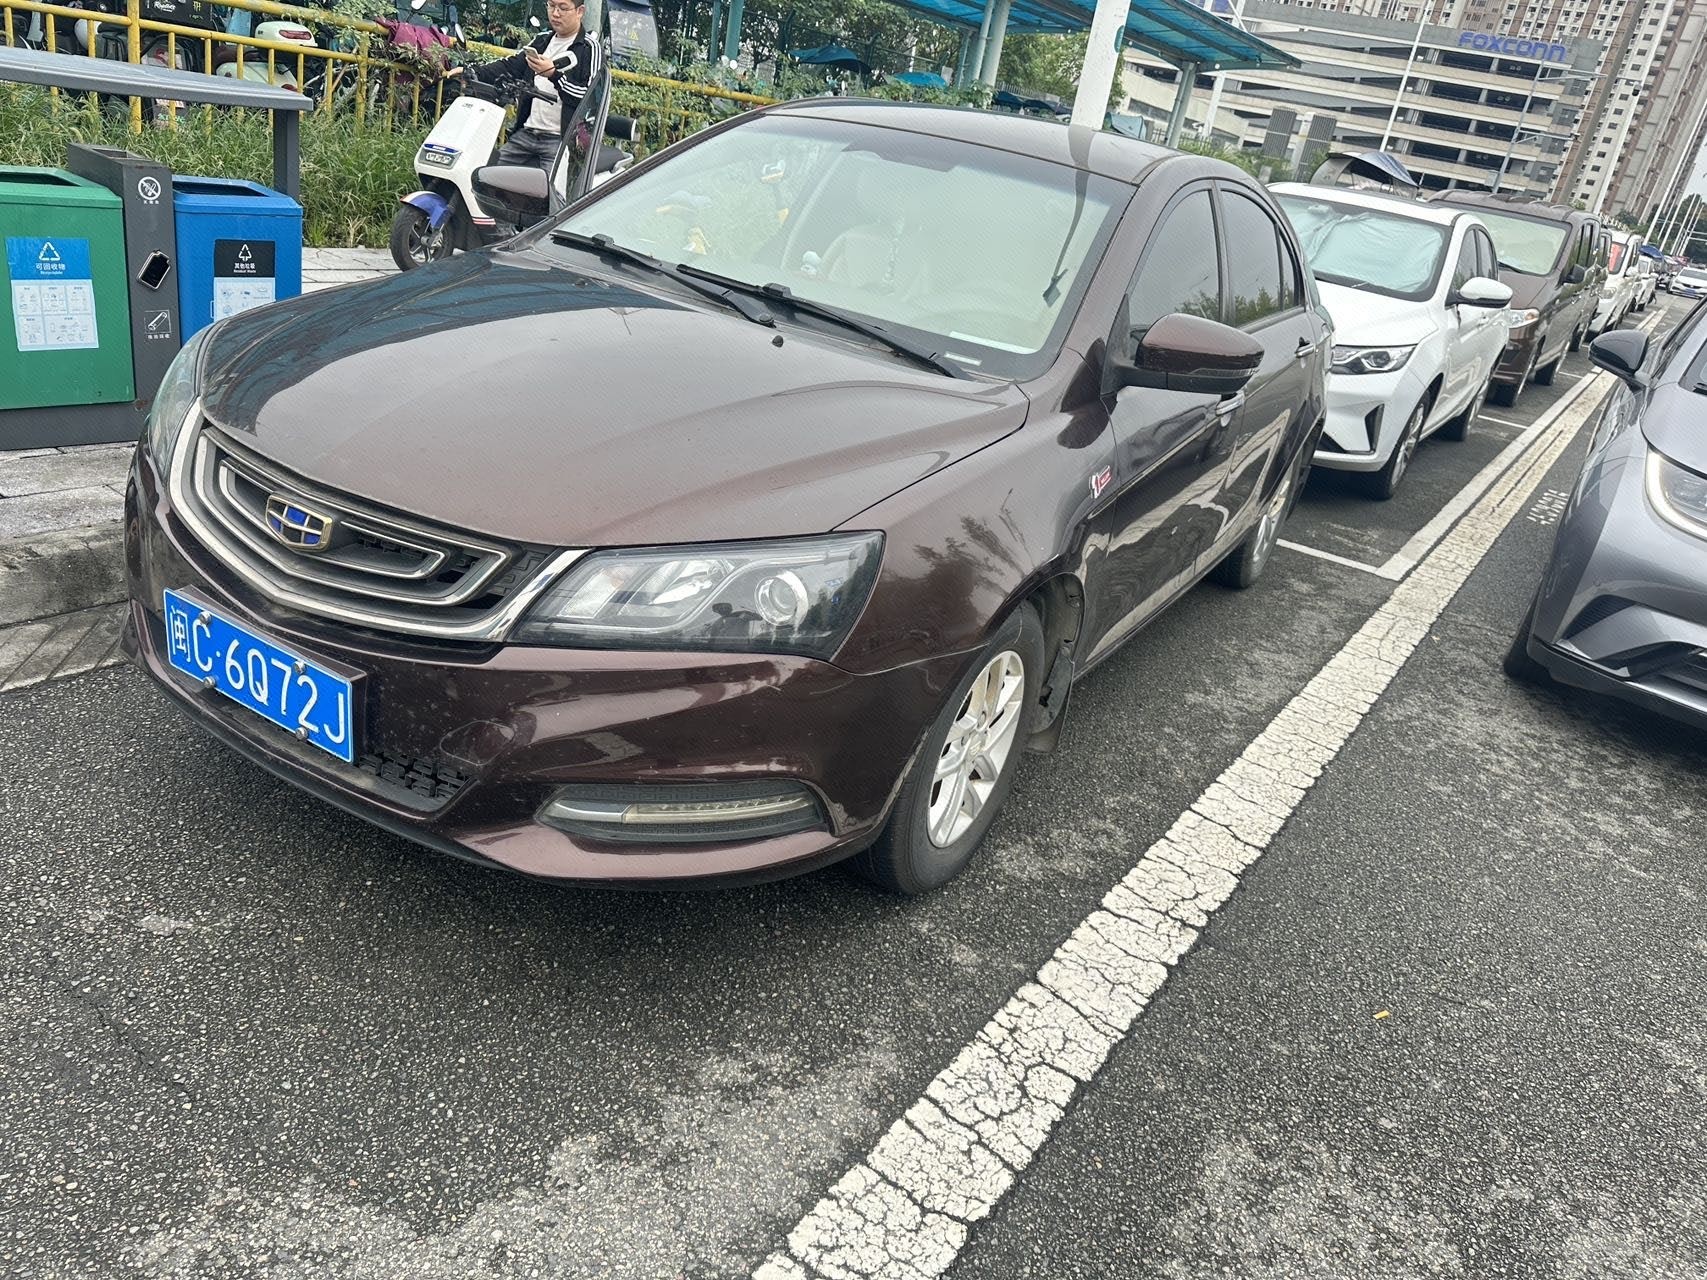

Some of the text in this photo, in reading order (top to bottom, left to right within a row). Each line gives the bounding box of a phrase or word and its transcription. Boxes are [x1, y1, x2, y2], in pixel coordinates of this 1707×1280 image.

[35, 262, 66, 271] 可回收物
[170, 605, 345, 744] 闽C·6Q72J
